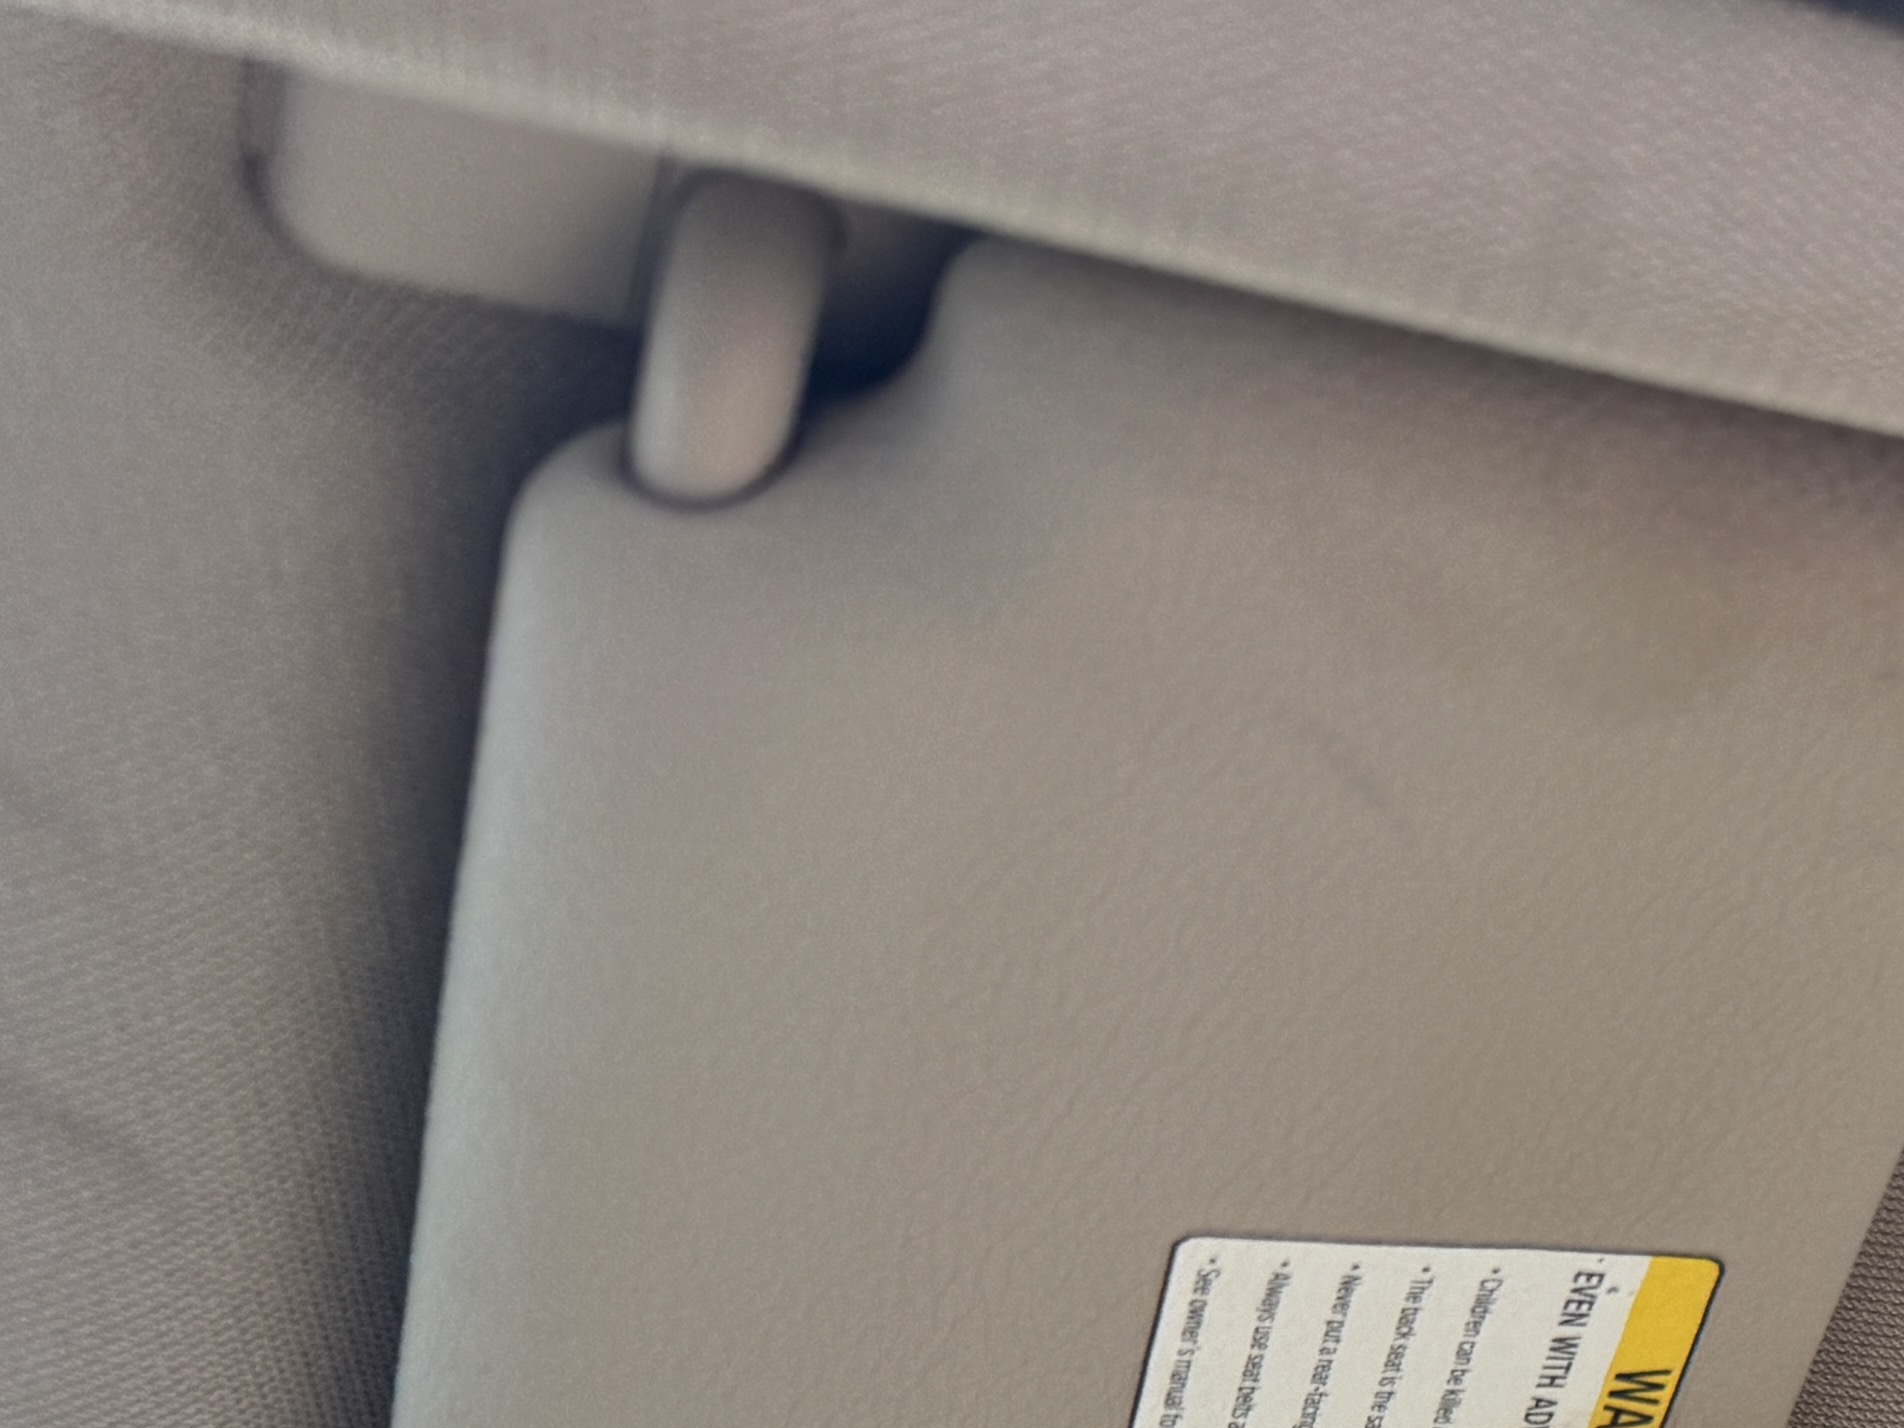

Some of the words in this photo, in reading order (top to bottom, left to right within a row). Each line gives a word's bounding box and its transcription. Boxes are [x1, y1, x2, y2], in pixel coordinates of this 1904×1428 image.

[1192, 1268, 1221, 1296] See
[1256, 1272, 1291, 1323] Always
[1331, 1274, 1362, 1317] Never
[1405, 1277, 1434, 1304] The
[1558, 1271, 1605, 1327] EVEN
[1394, 1306, 1422, 1341] back
[1464, 1278, 1503, 1338] Children
[1250, 1325, 1272, 1351] use
[1322, 1319, 1345, 1345] put
[1241, 1353, 1265, 1384] seat
[1382, 1343, 1408, 1374] seat
[1454, 1340, 1476, 1366] can
[1536, 1336, 1581, 1388] WITH
[1163, 1359, 1192, 1411] manual
[1231, 1385, 1259, 1420] belts
[1370, 1390, 1396, 1413] the
[1433, 1388, 1465, 1425] killed
